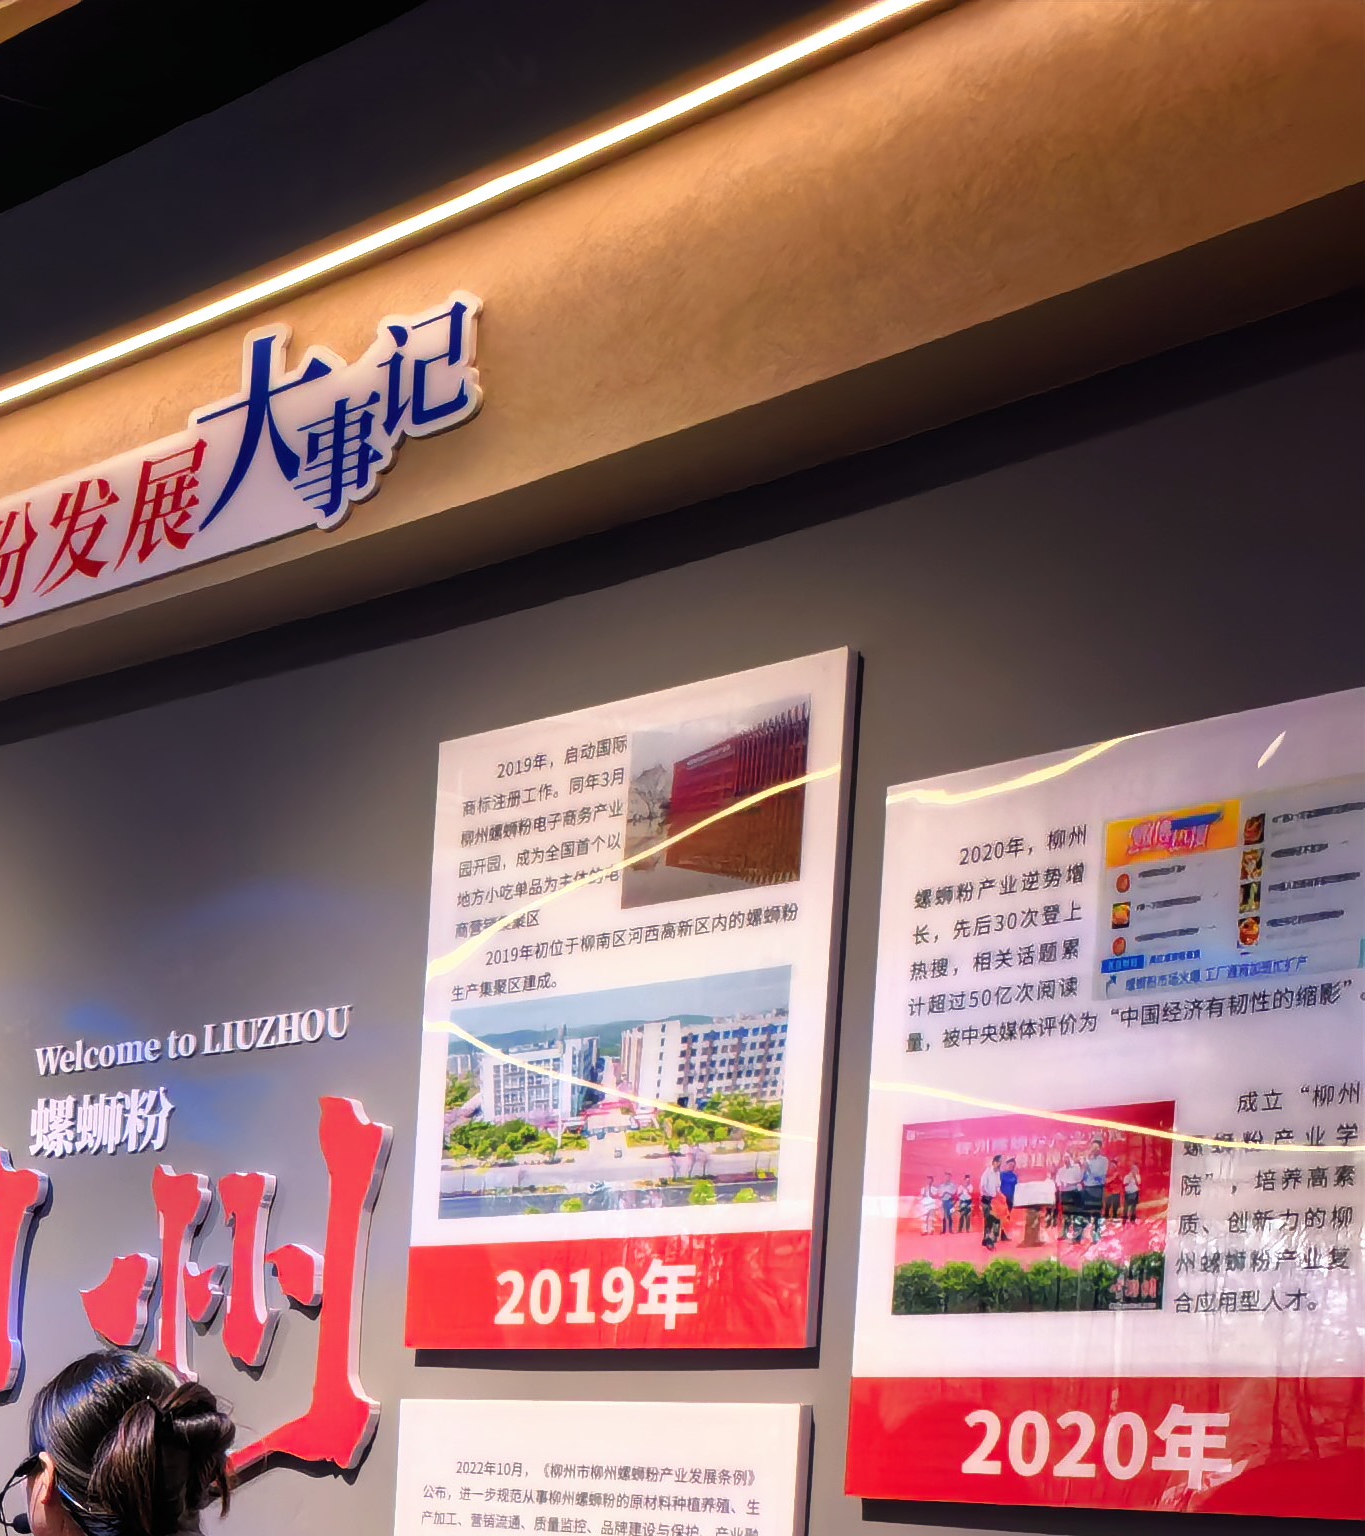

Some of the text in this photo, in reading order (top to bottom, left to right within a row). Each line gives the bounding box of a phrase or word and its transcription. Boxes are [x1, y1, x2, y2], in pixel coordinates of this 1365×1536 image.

[460, 799, 624, 848] 柳州螺蛳粉电子商务产业
[461, 767, 625, 817] 商标注册工作。同年3月
[913, 862, 1085, 910] 螺蛳粉产业逆势增
[485, 902, 799, 966] 2019年初位于柳南区河西高新区内的螺蛳粉
[908, 976, 1078, 1017] 计超过50亿次阅读
[34, 1004, 353, 1077] Welcome to LIUZHOU
[29, 1086, 175, 1157] 螺蛳粉
[494, 1258, 699, 1331] 2019年
[961, 1404, 1233, 1491] 2020年
